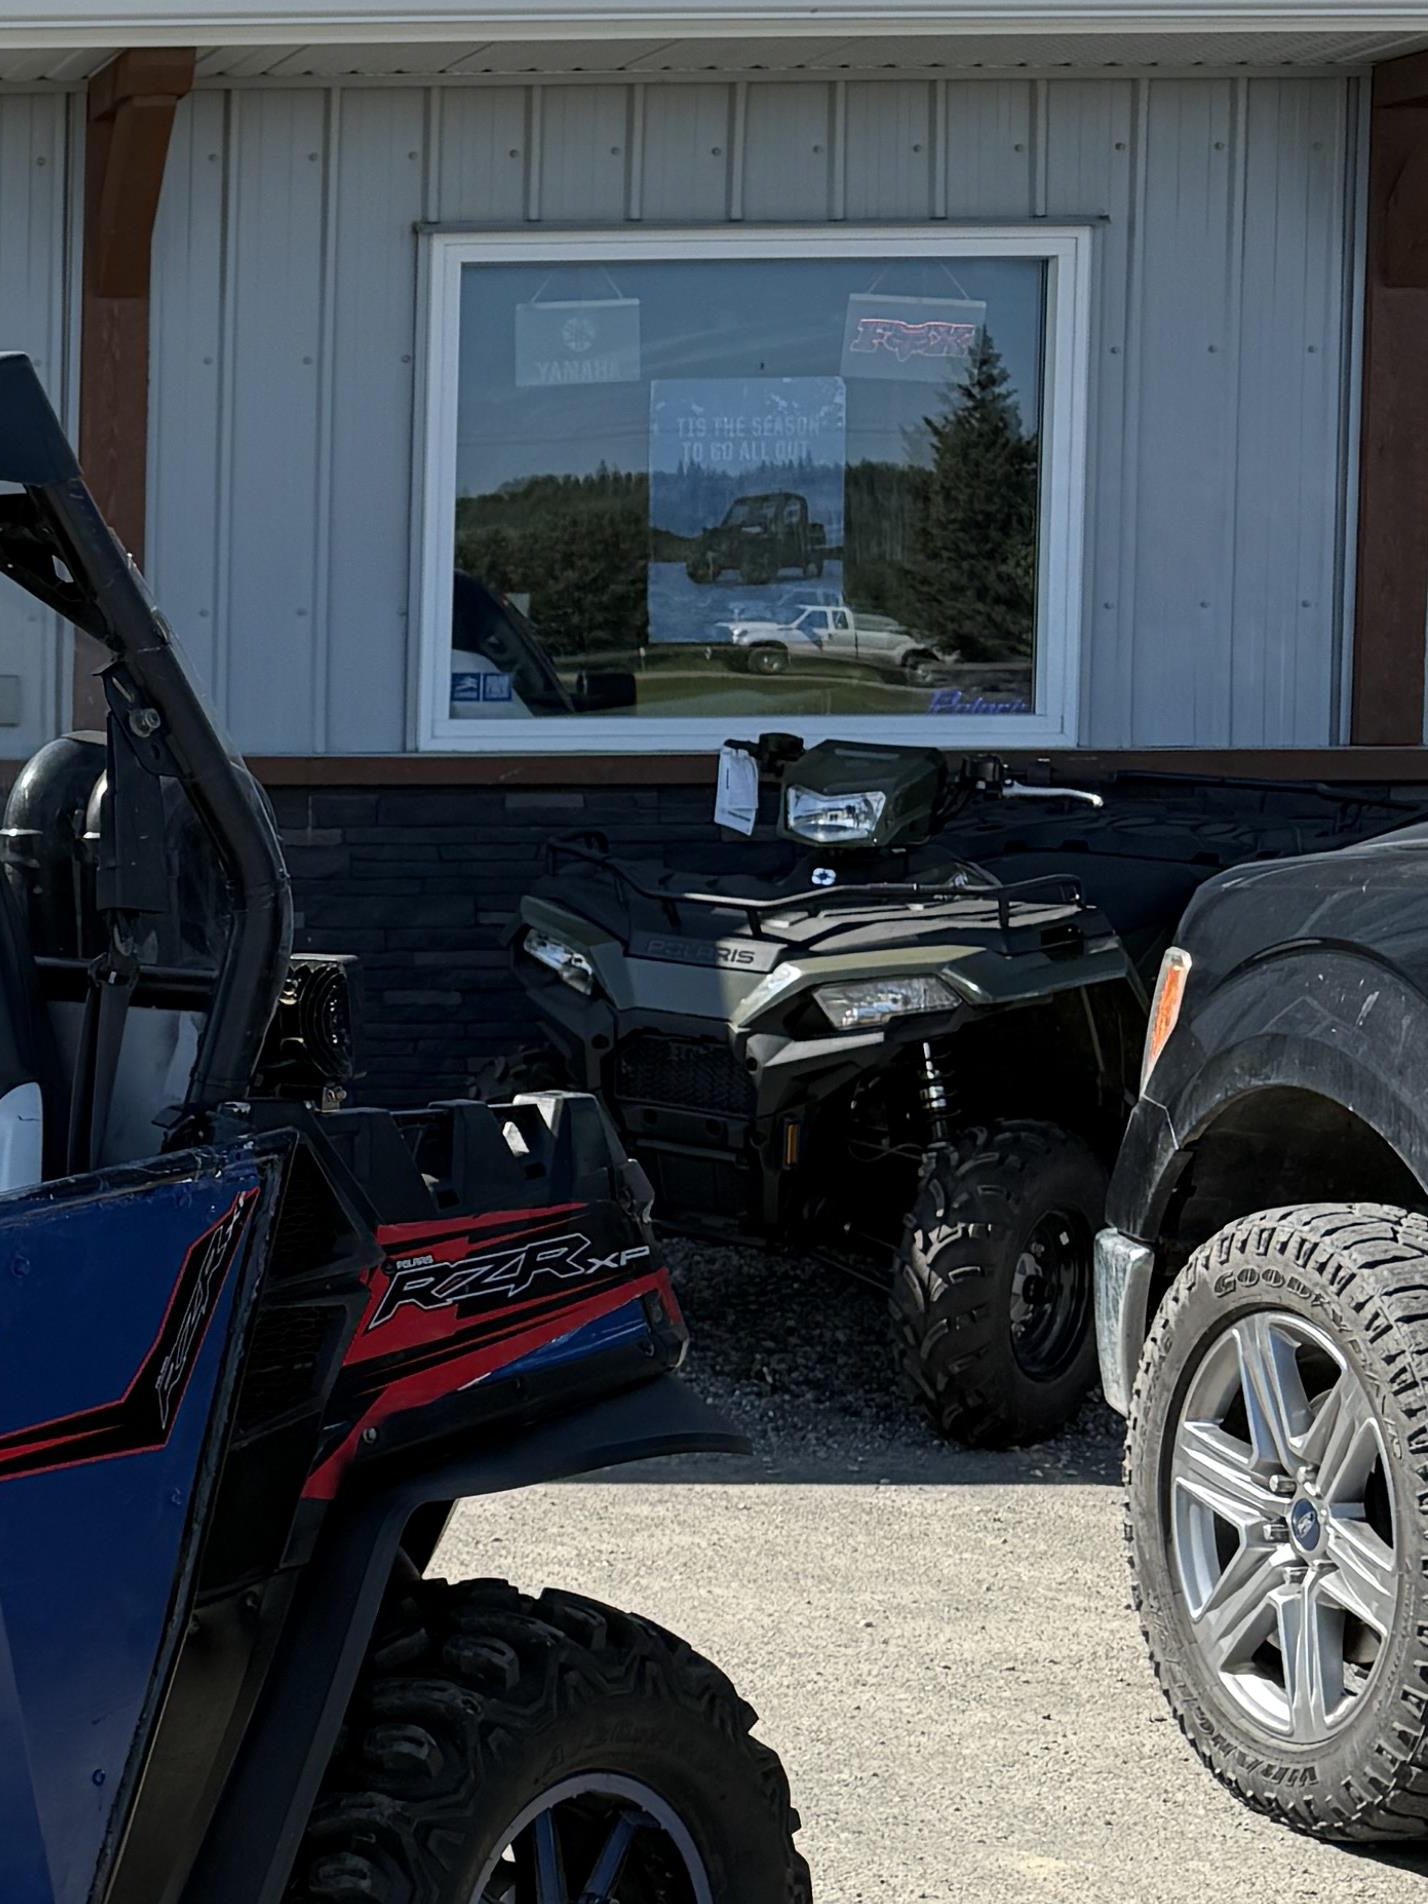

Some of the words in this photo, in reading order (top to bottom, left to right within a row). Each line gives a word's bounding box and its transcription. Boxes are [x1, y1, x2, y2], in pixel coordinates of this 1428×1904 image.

[534, 359, 621, 384] YAMAHA
[712, 415, 744, 438] THE
[751, 416, 821, 437] SEASON
[396, 1254, 434, 1270] POLARIS
[367, 1232, 592, 1330] RZR
[584, 1245, 651, 1275] XP
